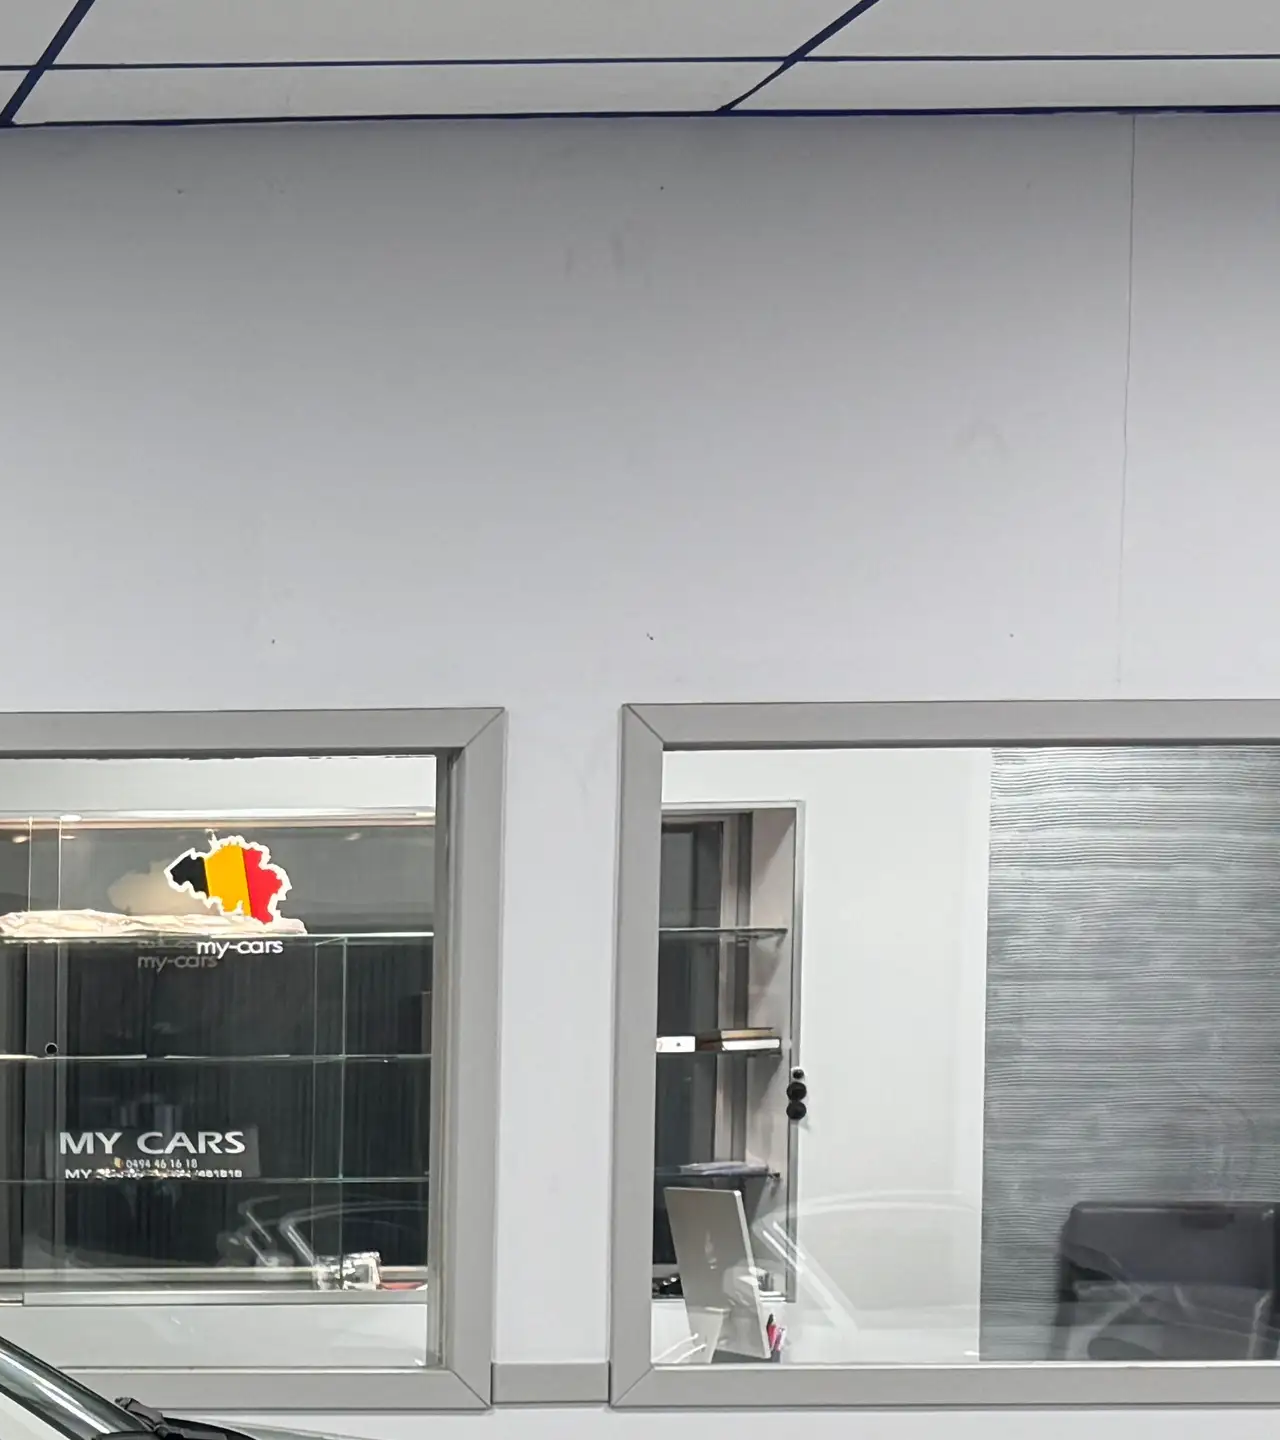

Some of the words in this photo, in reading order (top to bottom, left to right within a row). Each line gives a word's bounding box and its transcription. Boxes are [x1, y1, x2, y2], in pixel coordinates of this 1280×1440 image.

[196, 940, 284, 959] my-cars
[59, 1131, 123, 1155] MY
[136, 1131, 246, 1155] CARS
[170, 1158, 182, 1169] 16
[185, 1158, 198, 1169] 18
[64, 1168, 93, 1179] MY
